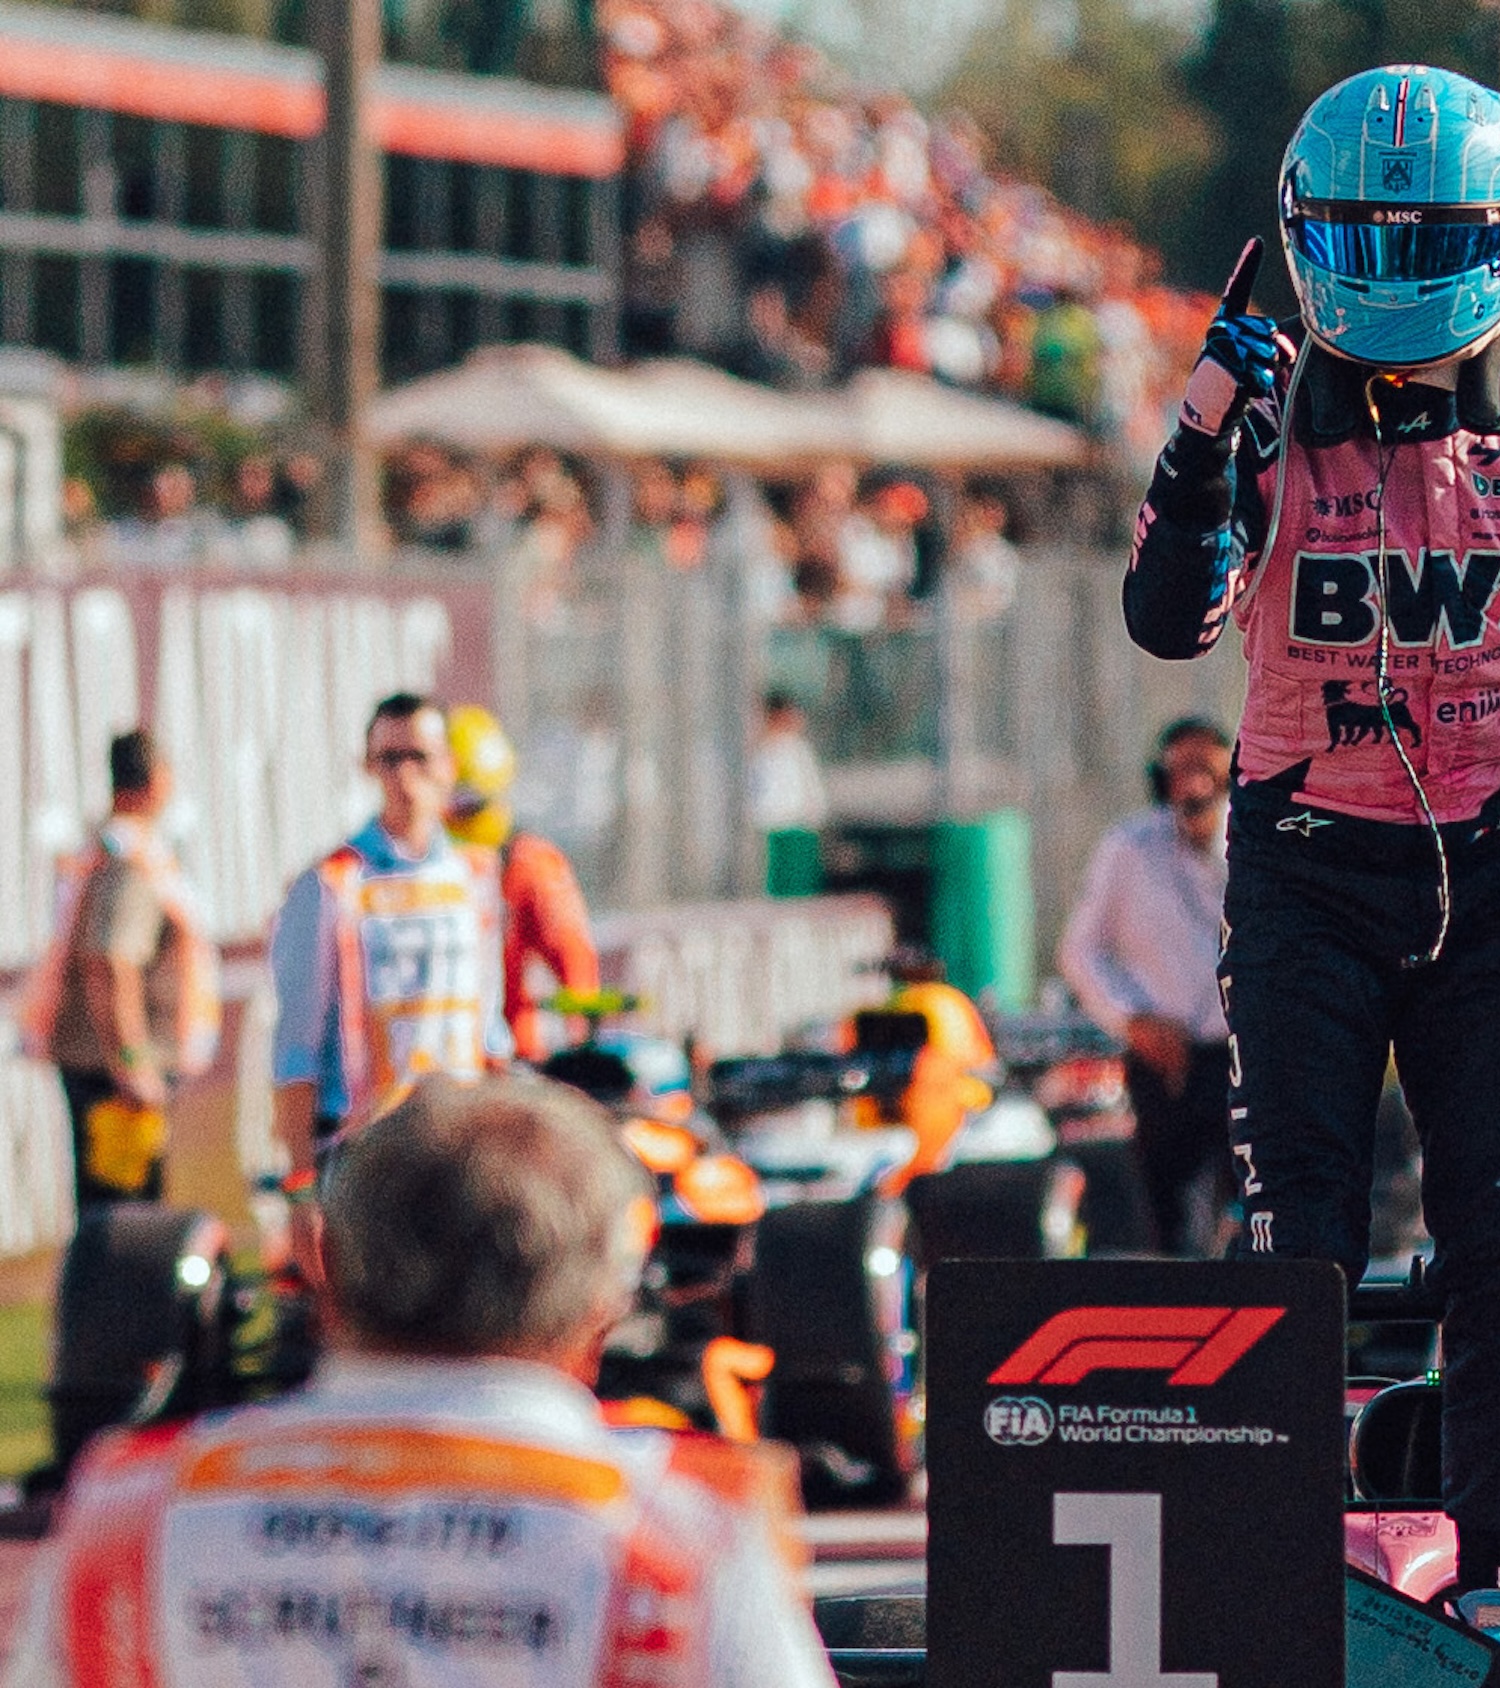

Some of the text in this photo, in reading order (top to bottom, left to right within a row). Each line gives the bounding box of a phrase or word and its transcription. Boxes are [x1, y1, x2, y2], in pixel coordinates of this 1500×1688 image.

[1386, 210, 1422, 225] MSC
[1334, 490, 1381, 517] MSC
[1287, 646, 1340, 665] BEST
[986, 1307, 1288, 1385] F1
[1059, 1405, 1198, 1424] FIA Formula 1
[1059, 1425, 1122, 1442] World
[1052, 1492, 1219, 1688] 1
